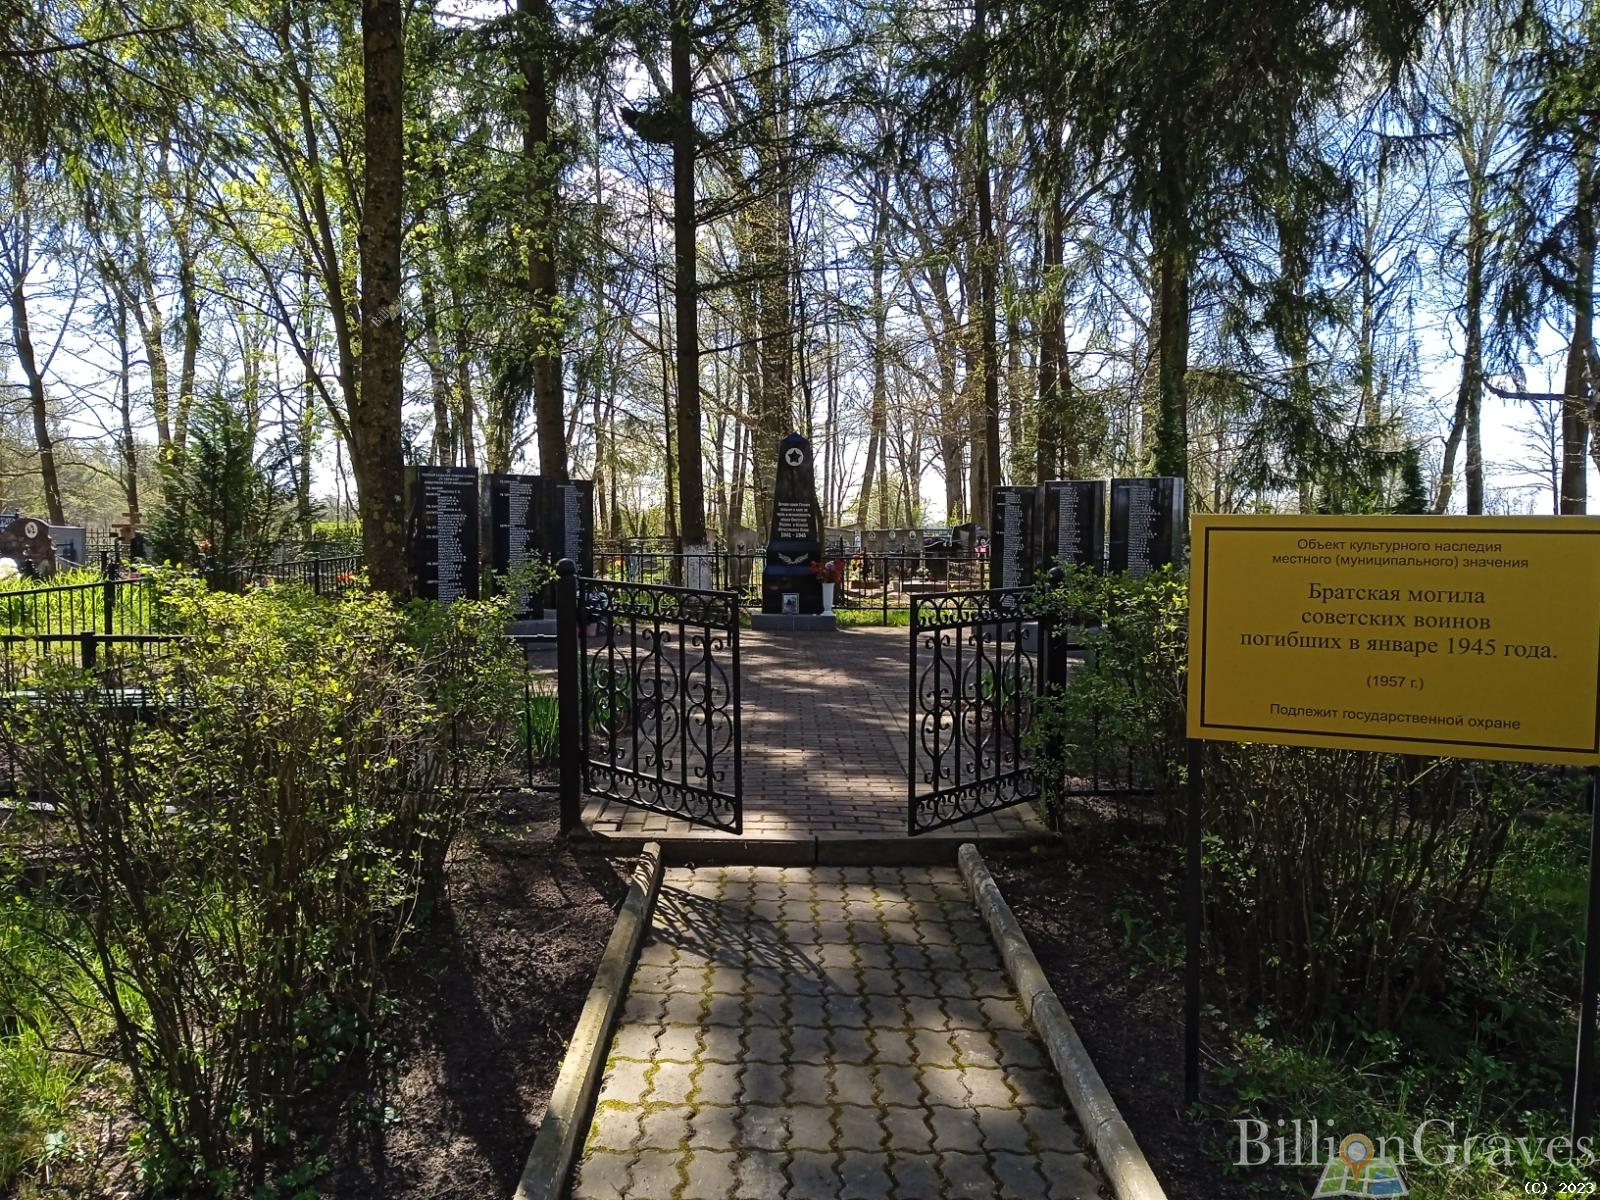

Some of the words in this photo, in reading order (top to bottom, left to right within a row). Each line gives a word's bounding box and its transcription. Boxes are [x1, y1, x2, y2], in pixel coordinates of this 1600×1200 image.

[1297, 538, 1346, 551] Объект
[1349, 540, 1430, 553] культурного
[1434, 542, 1502, 554] наследия
[1272, 555, 1331, 567] местного
[1335, 555, 1459, 569] (муниципального)
[1462, 558, 1529, 569] значения
[1308, 582, 1401, 604] Братская
[1407, 589, 1485, 604] могила
[1301, 611, 1405, 628] советских
[1413, 615, 1491, 630] воинов
[1240, 630, 1342, 650] погибших
[1348, 639, 1360, 650] в
[1366, 639, 1438, 657] январе
[1447, 637, 1496, 656] 1945
[1503, 643, 1558, 659] года.
[1366, 674, 1406, 690] (1957
[1410, 676, 1424, 691] г.)
[1270, 703, 1338, 719] Подлежит
[1342, 709, 1464, 728] государственной
[1468, 717, 1521, 731] охране
